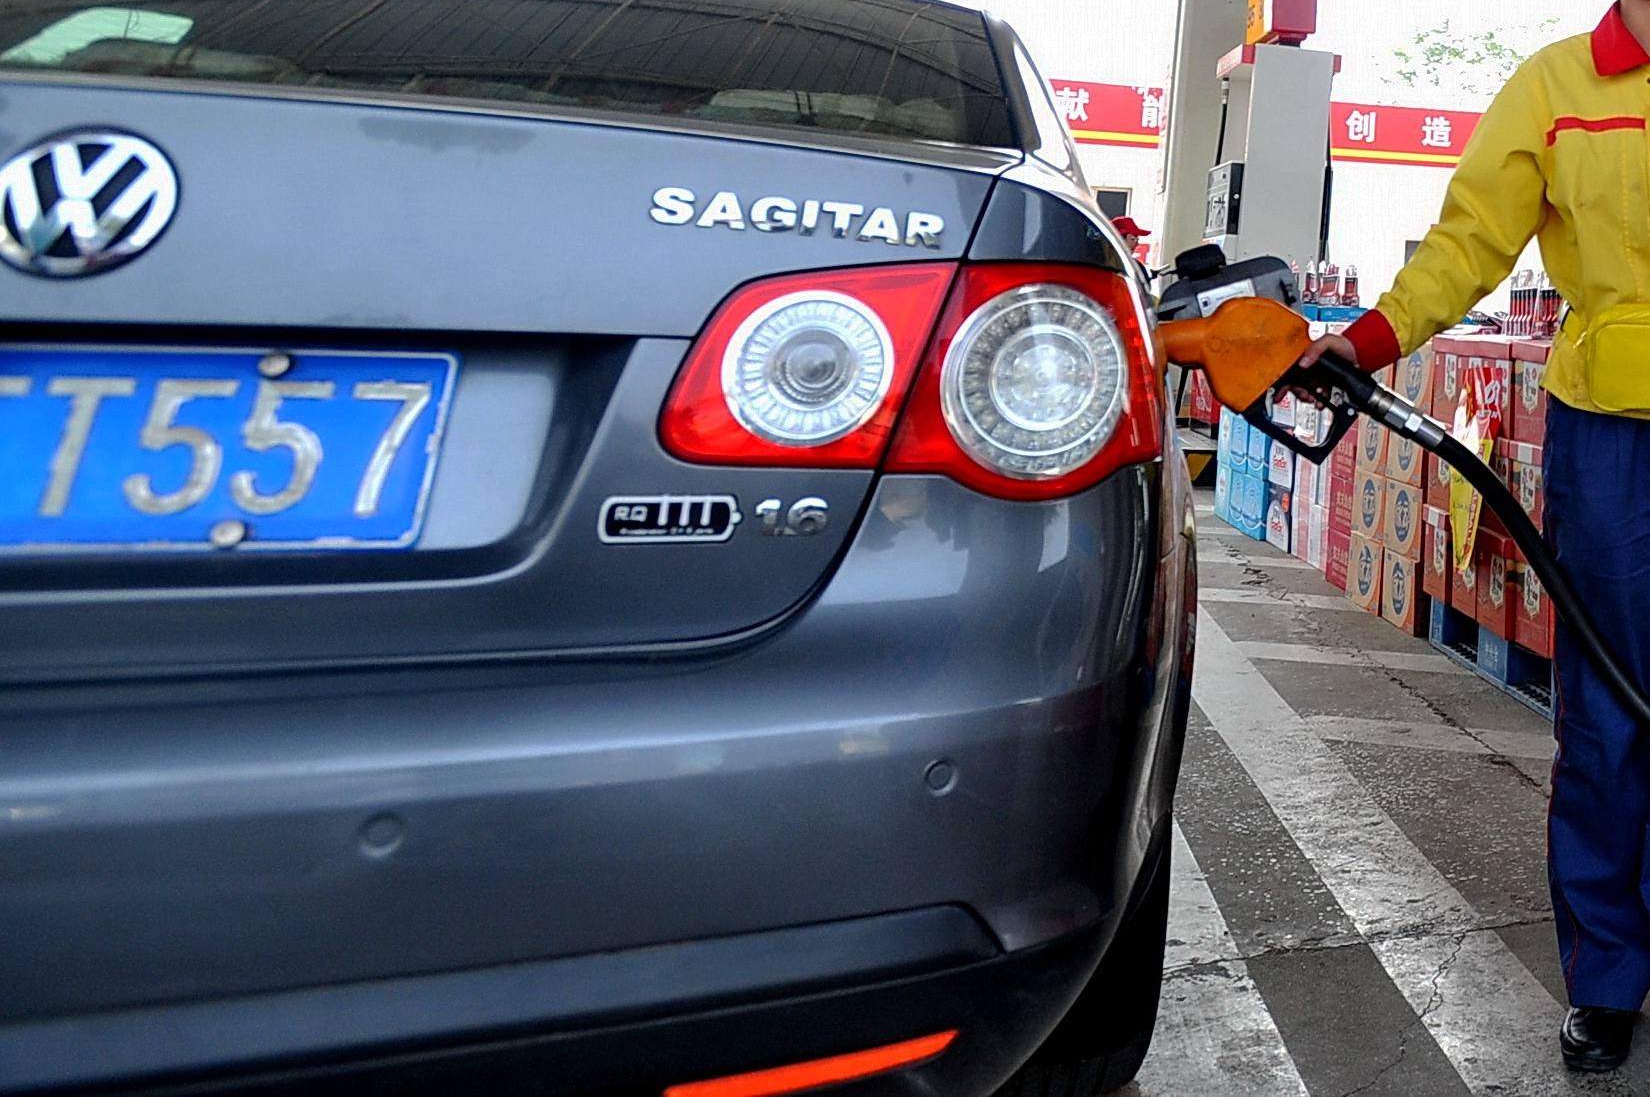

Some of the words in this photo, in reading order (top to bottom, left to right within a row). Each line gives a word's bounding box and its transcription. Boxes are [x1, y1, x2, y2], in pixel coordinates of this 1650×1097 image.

[1345, 109, 1453, 148] 创造
[650, 186, 946, 249] SAGITAR
[0, 377, 432, 517] T557
[755, 497, 829, 536] 1.6
